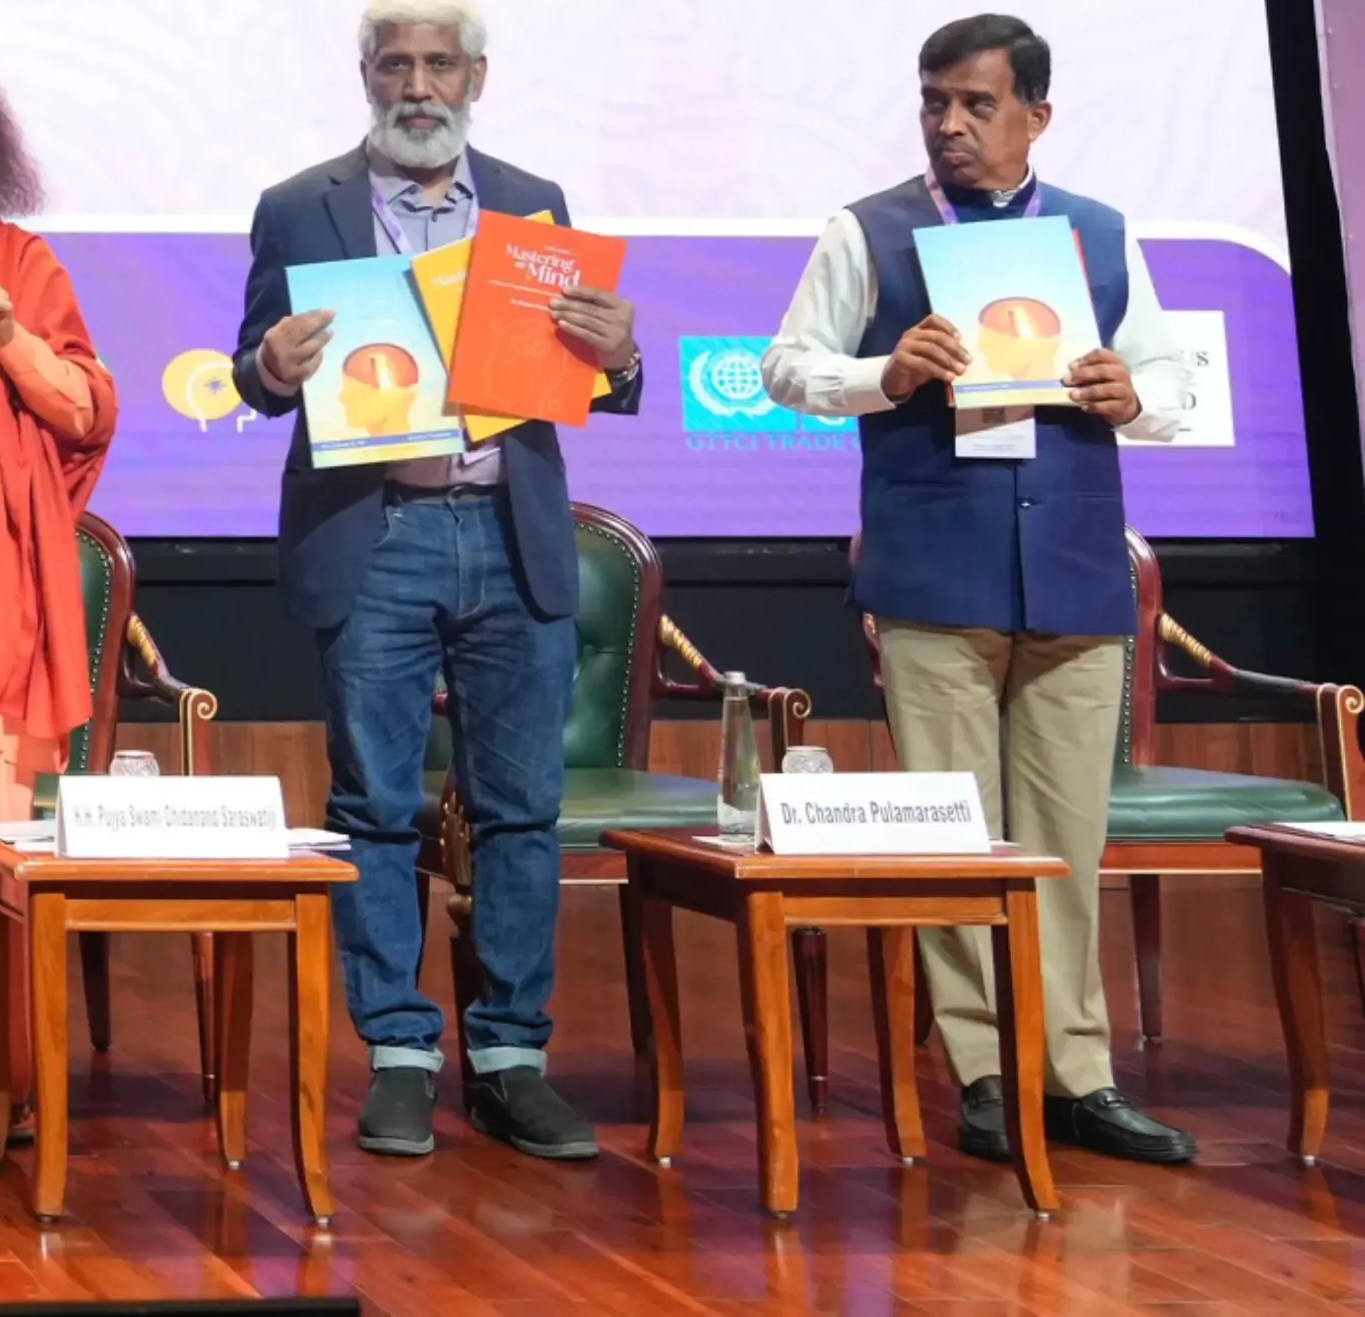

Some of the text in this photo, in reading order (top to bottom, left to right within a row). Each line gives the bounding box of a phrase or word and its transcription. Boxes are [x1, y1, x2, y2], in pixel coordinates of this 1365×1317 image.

[505, 242, 575, 274] Mastering
[525, 261, 582, 288] Mind
[780, 799, 973, 825] Dr. Chandra Pulamarasetti
